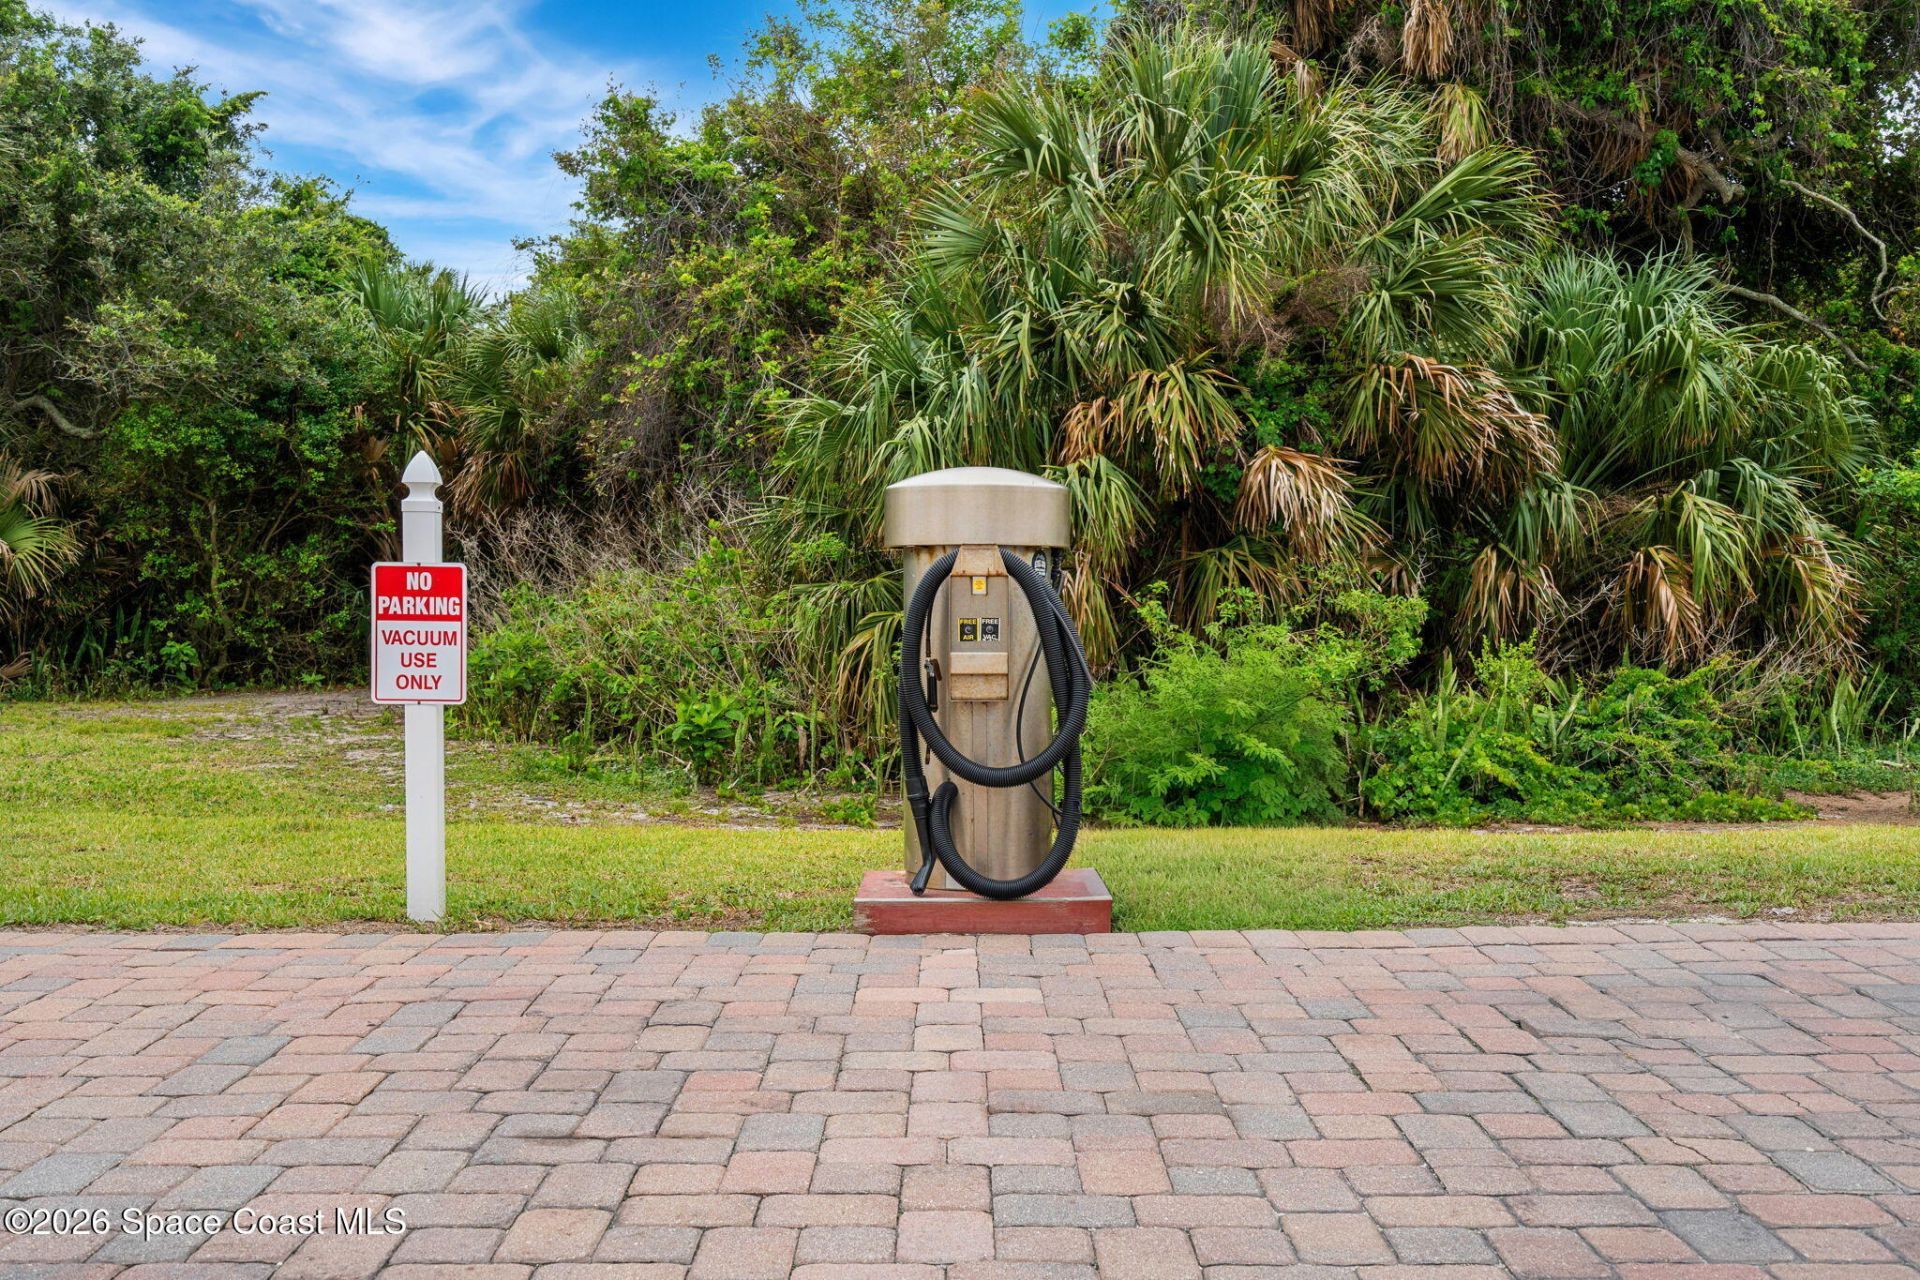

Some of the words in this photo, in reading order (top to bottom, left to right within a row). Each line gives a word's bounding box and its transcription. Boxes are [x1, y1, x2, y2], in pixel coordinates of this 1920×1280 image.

[406, 572, 432, 591] NO
[378, 596, 460, 616] PARKING
[382, 630, 457, 646] VACUUM
[401, 653, 437, 668] USE
[396, 674, 442, 690] ONLY
